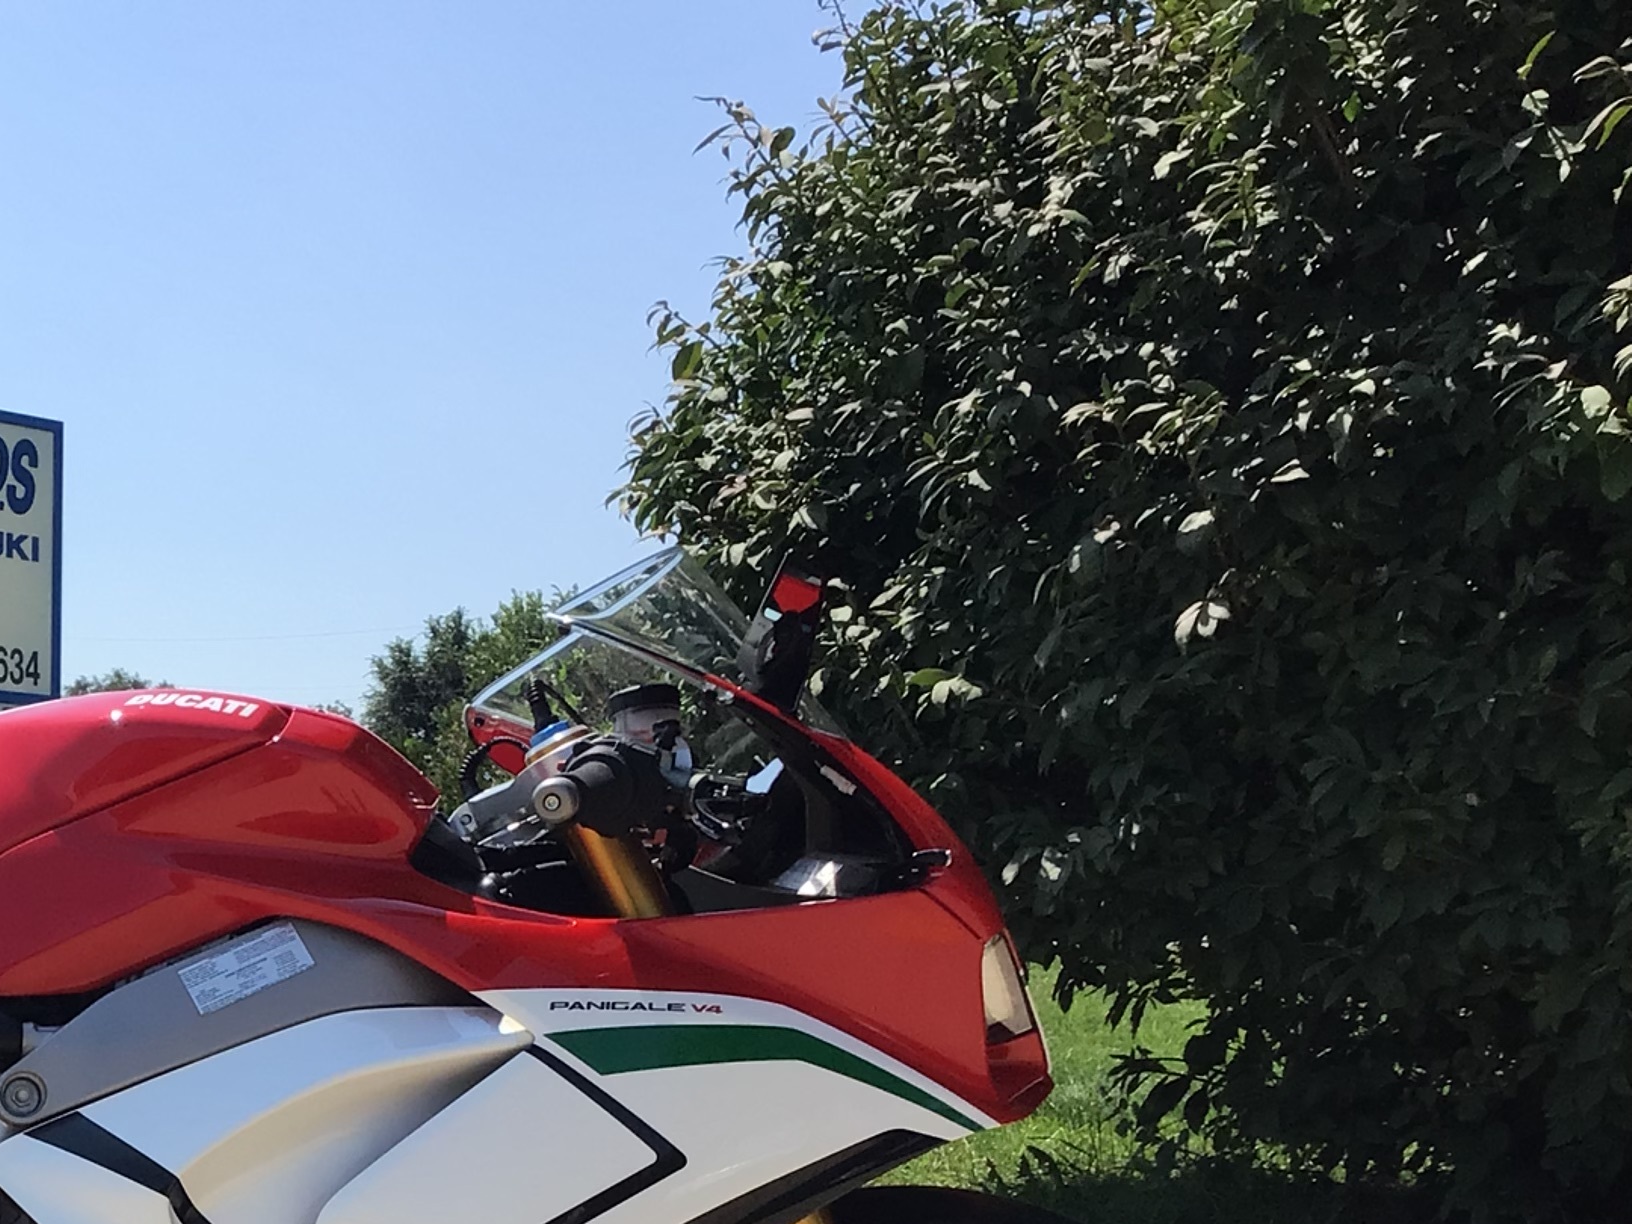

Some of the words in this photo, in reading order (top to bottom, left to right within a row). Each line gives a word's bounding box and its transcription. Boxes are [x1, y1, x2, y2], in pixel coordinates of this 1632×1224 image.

[124, 693, 260, 718] DUCATI
[549, 1001, 686, 1012] PANIGALE
[691, 1003, 723, 1014] V4
